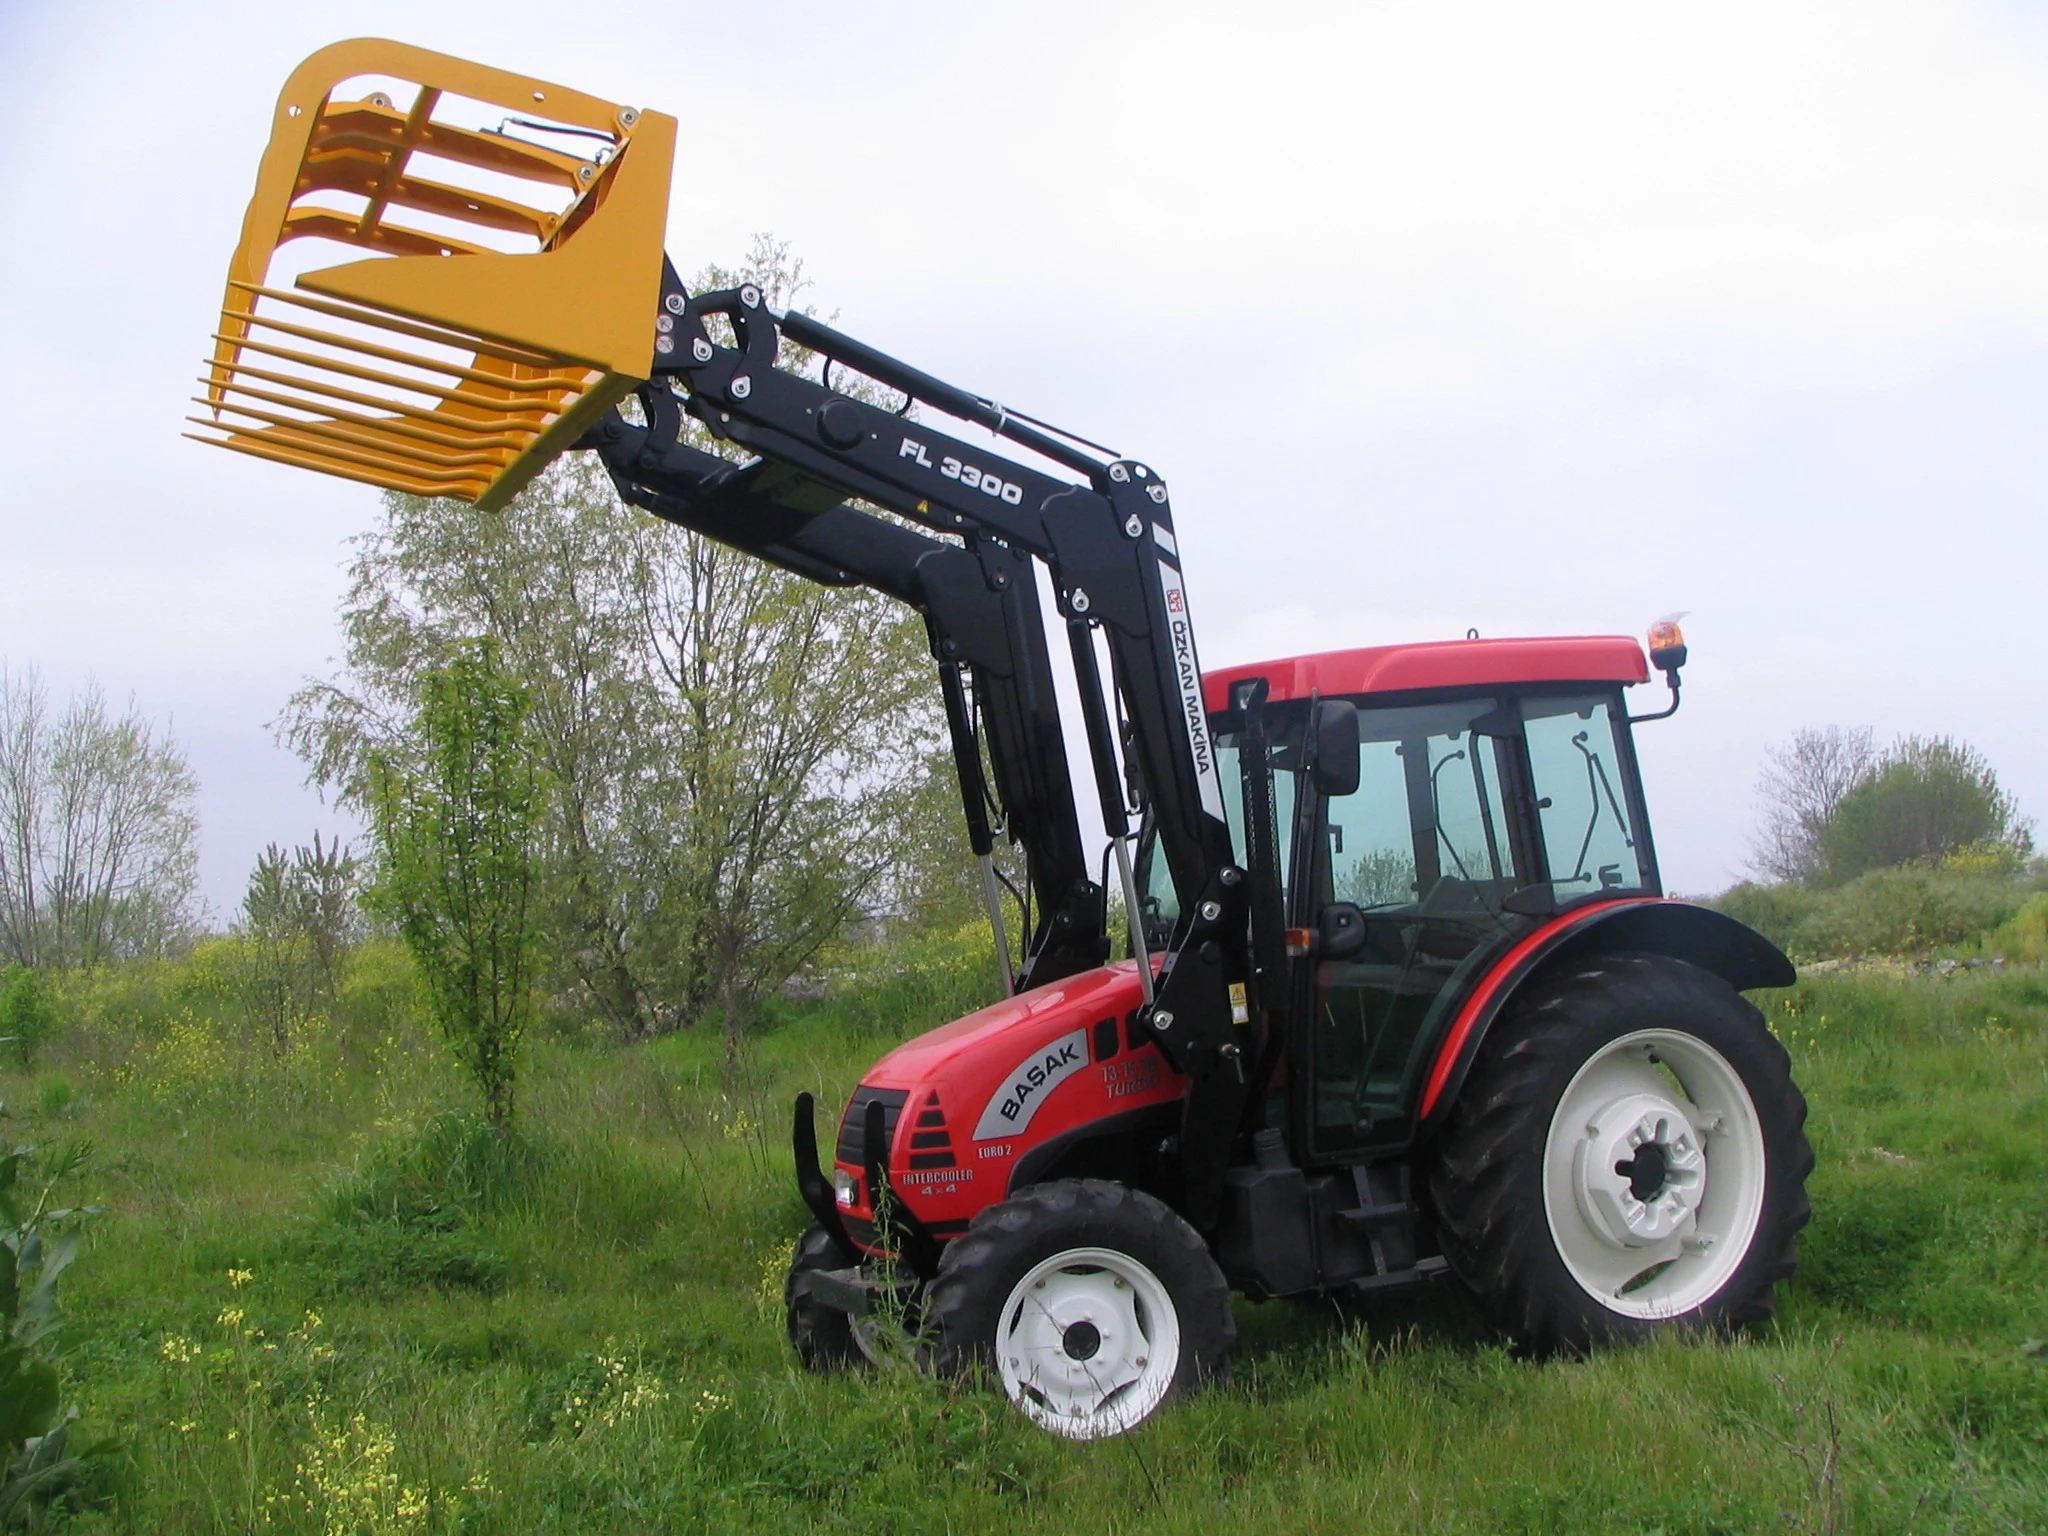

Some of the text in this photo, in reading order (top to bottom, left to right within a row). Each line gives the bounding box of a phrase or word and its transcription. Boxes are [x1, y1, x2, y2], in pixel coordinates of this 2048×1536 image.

[900, 438, 1023, 505] FL 3300
[1172, 621, 1210, 775] ÖZKAN MAKİNA
[1000, 1042, 1080, 1122] BAŞAK
[902, 1169, 973, 1185] INTERCOOLER
[978, 1144, 1013, 1159] EURO 2
